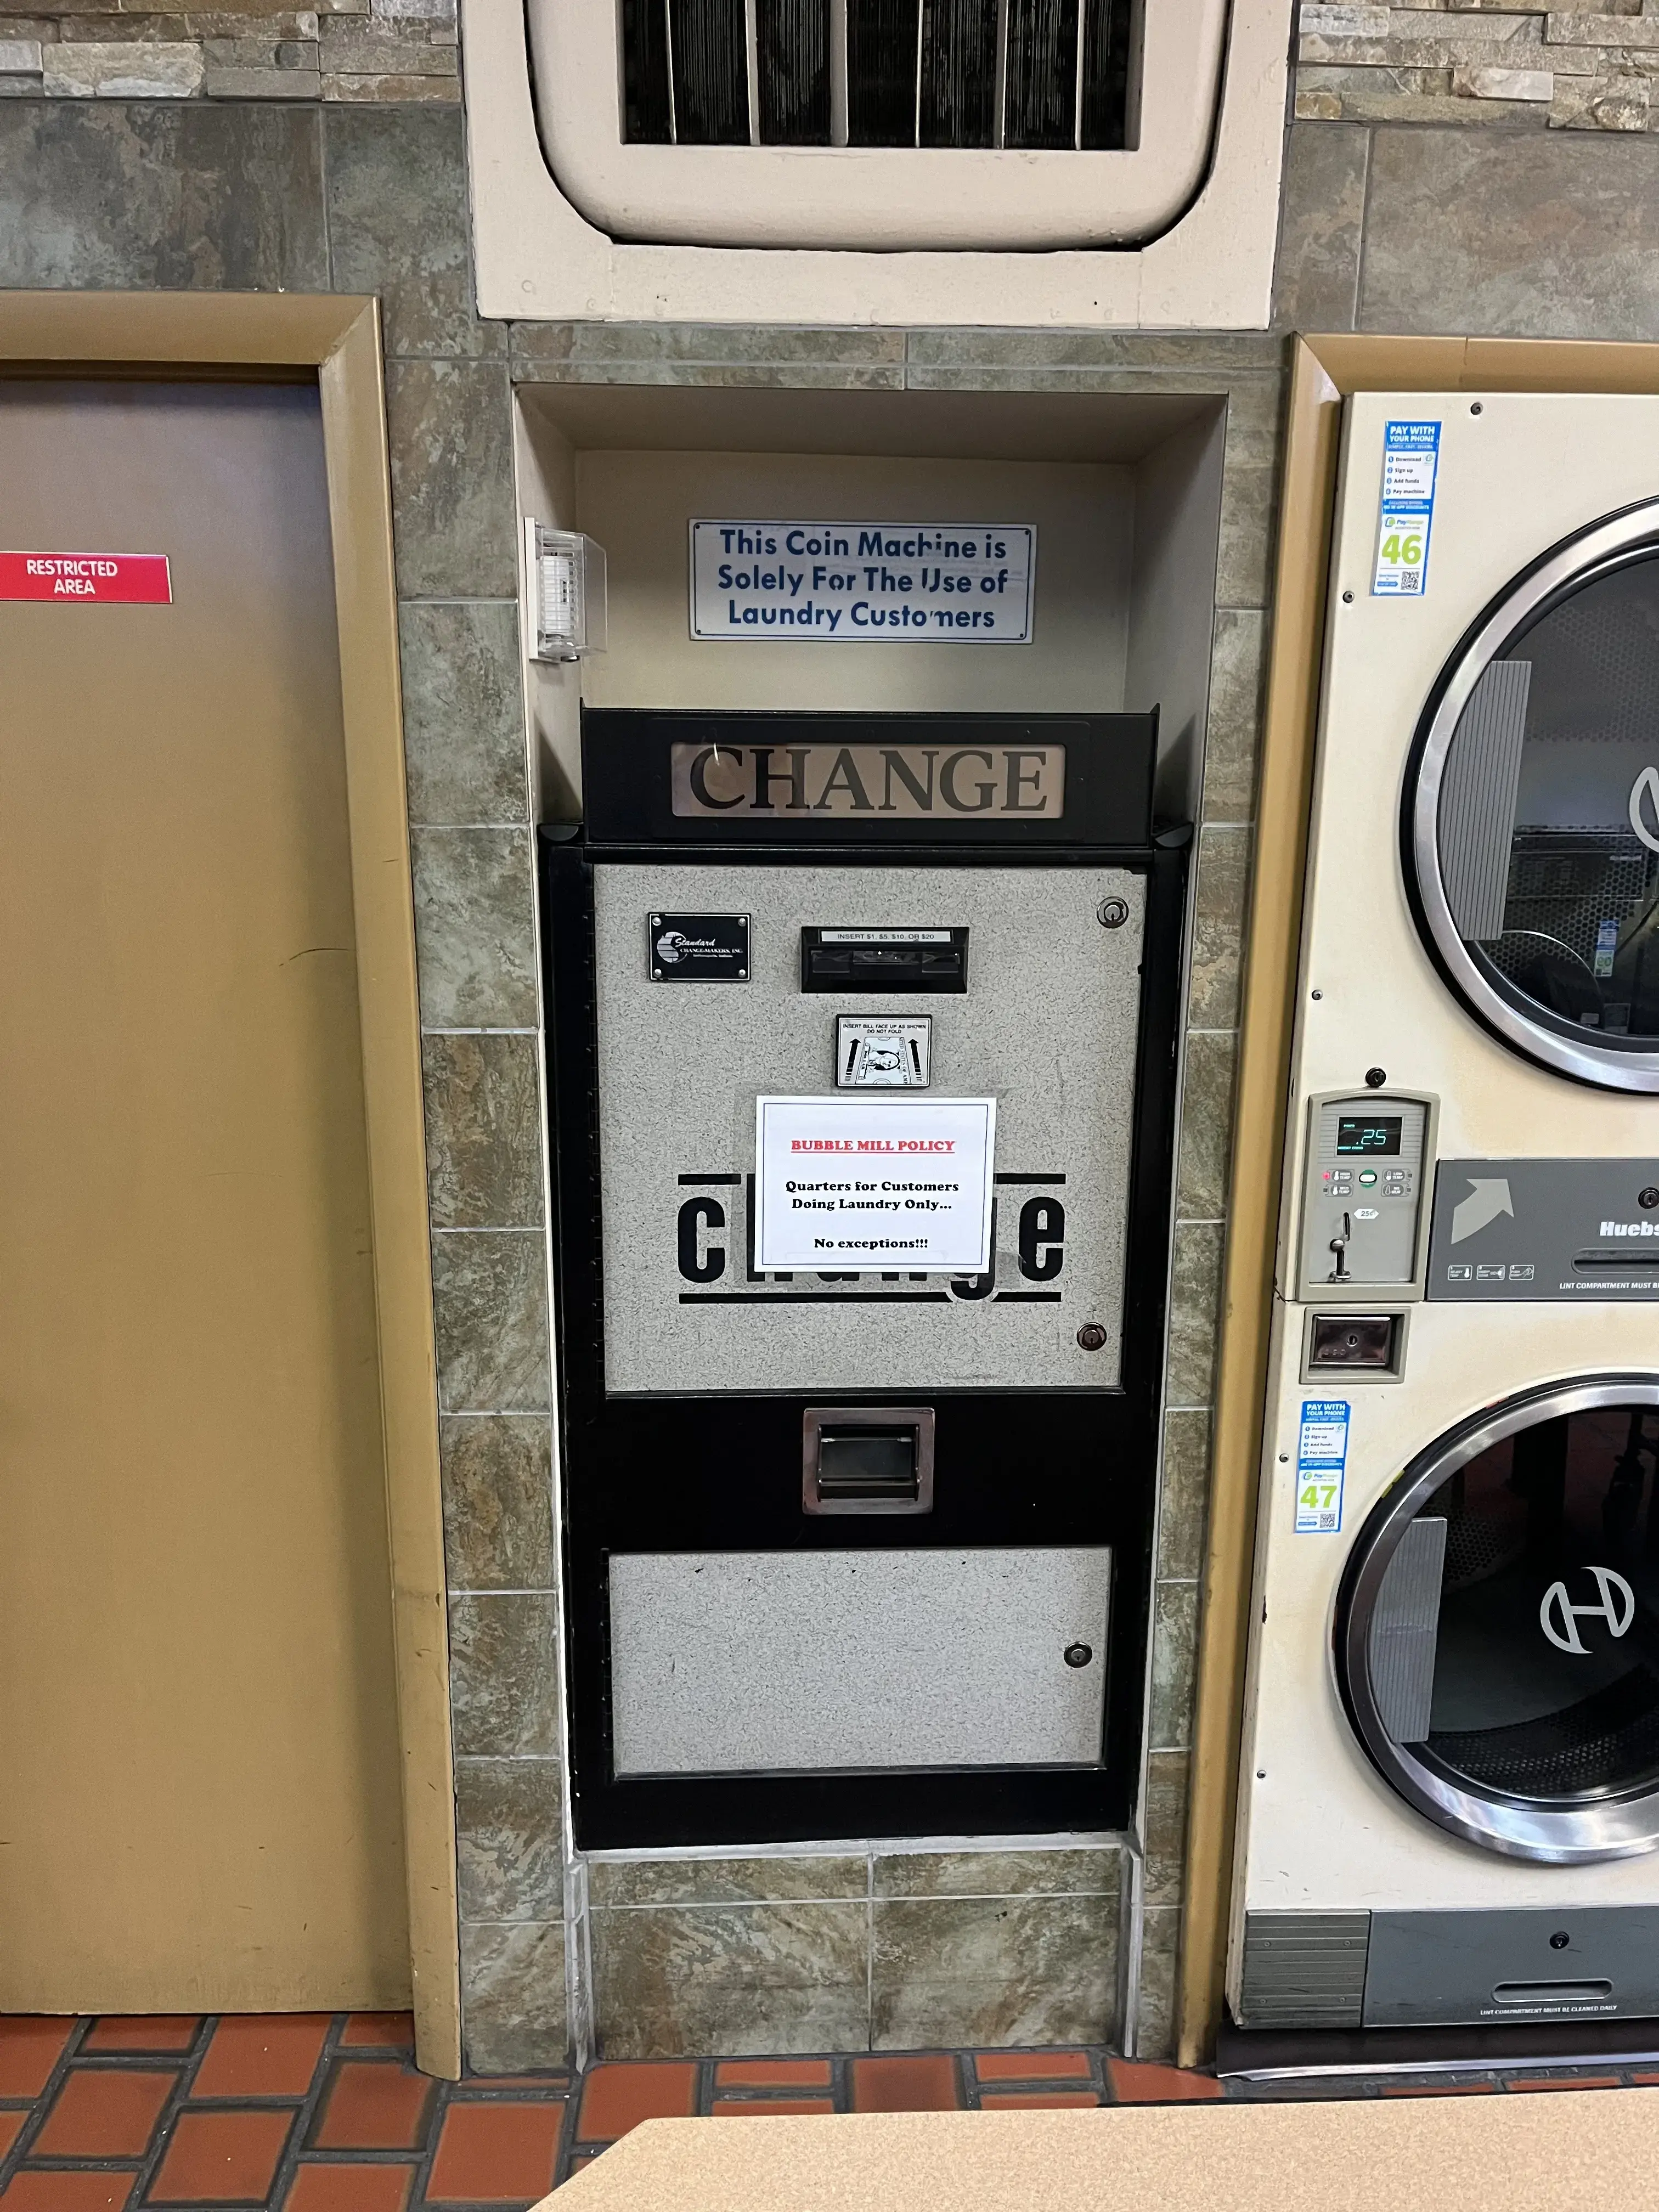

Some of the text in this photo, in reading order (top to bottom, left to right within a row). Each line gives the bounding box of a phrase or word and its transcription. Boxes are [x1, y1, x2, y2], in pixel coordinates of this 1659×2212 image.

[1390, 426, 1435, 435] PAY WITH
[720, 529, 1006, 558] This Coin Machine is
[1382, 534, 1422, 565] 46
[27, 560, 117, 576] RESTRICTED
[54, 579, 95, 594] AREA
[718, 565, 1007, 596] Solely For The Use of
[729, 600, 994, 631] Laundry Customers
[690, 747, 1047, 812] CHANGE
[675, 938, 715, 947] Standard
[1356, 1130, 1387, 1145] .25
[791, 1141, 955, 1151] BUBBLE MILL POLICY
[786, 1181, 959, 1192] Quarters for Customers
[792, 1199, 952, 1211] Doing Laundry Only...
[814, 1239, 928, 1250] No exceptions!!!
[1300, 1486, 1337, 1508] 47
